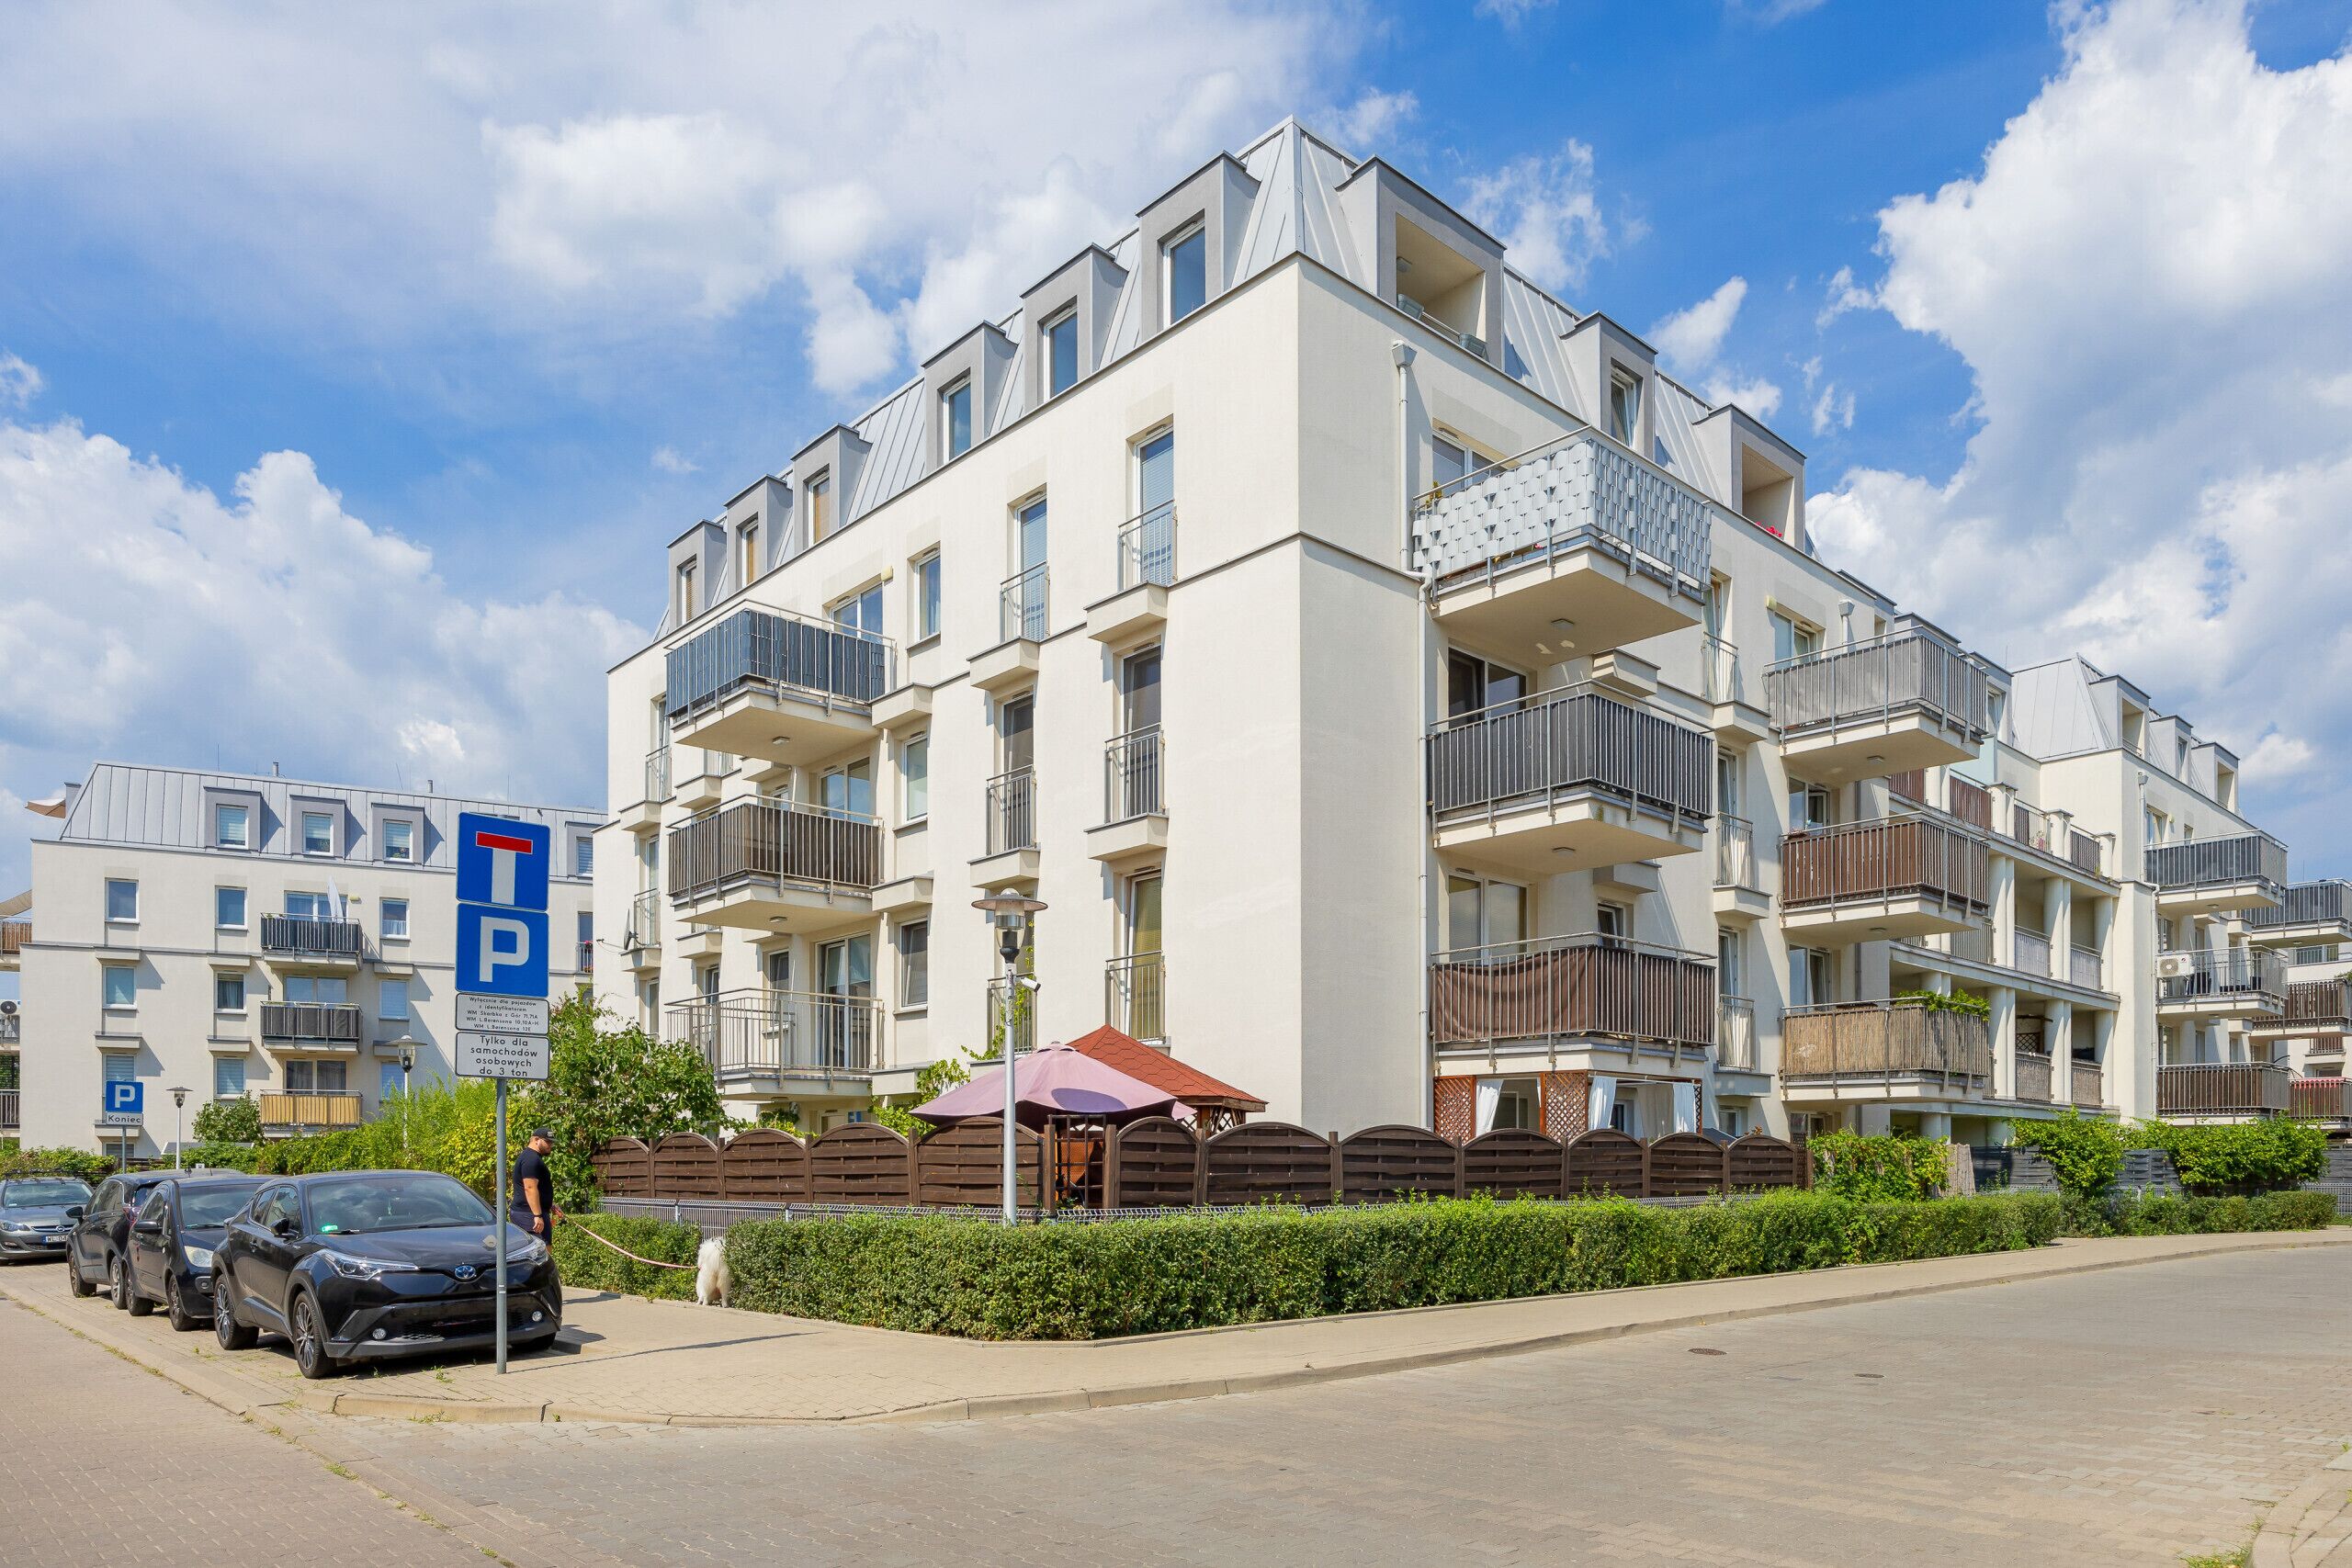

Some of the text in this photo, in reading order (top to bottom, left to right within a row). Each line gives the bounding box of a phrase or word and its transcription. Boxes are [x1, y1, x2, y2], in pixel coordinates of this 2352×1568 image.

[479, 916, 530, 983] P
[484, 1004, 527, 1012] identyfikatorem
[480, 1035, 528, 1046] Tylko dla
[470, 1047, 538, 1057] samochodów
[475, 1057, 532, 1068] osobowych
[479, 1066, 528, 1077] do 3 ton
[115, 1084, 135, 1108] P
[107, 1114, 141, 1123] Koniec
